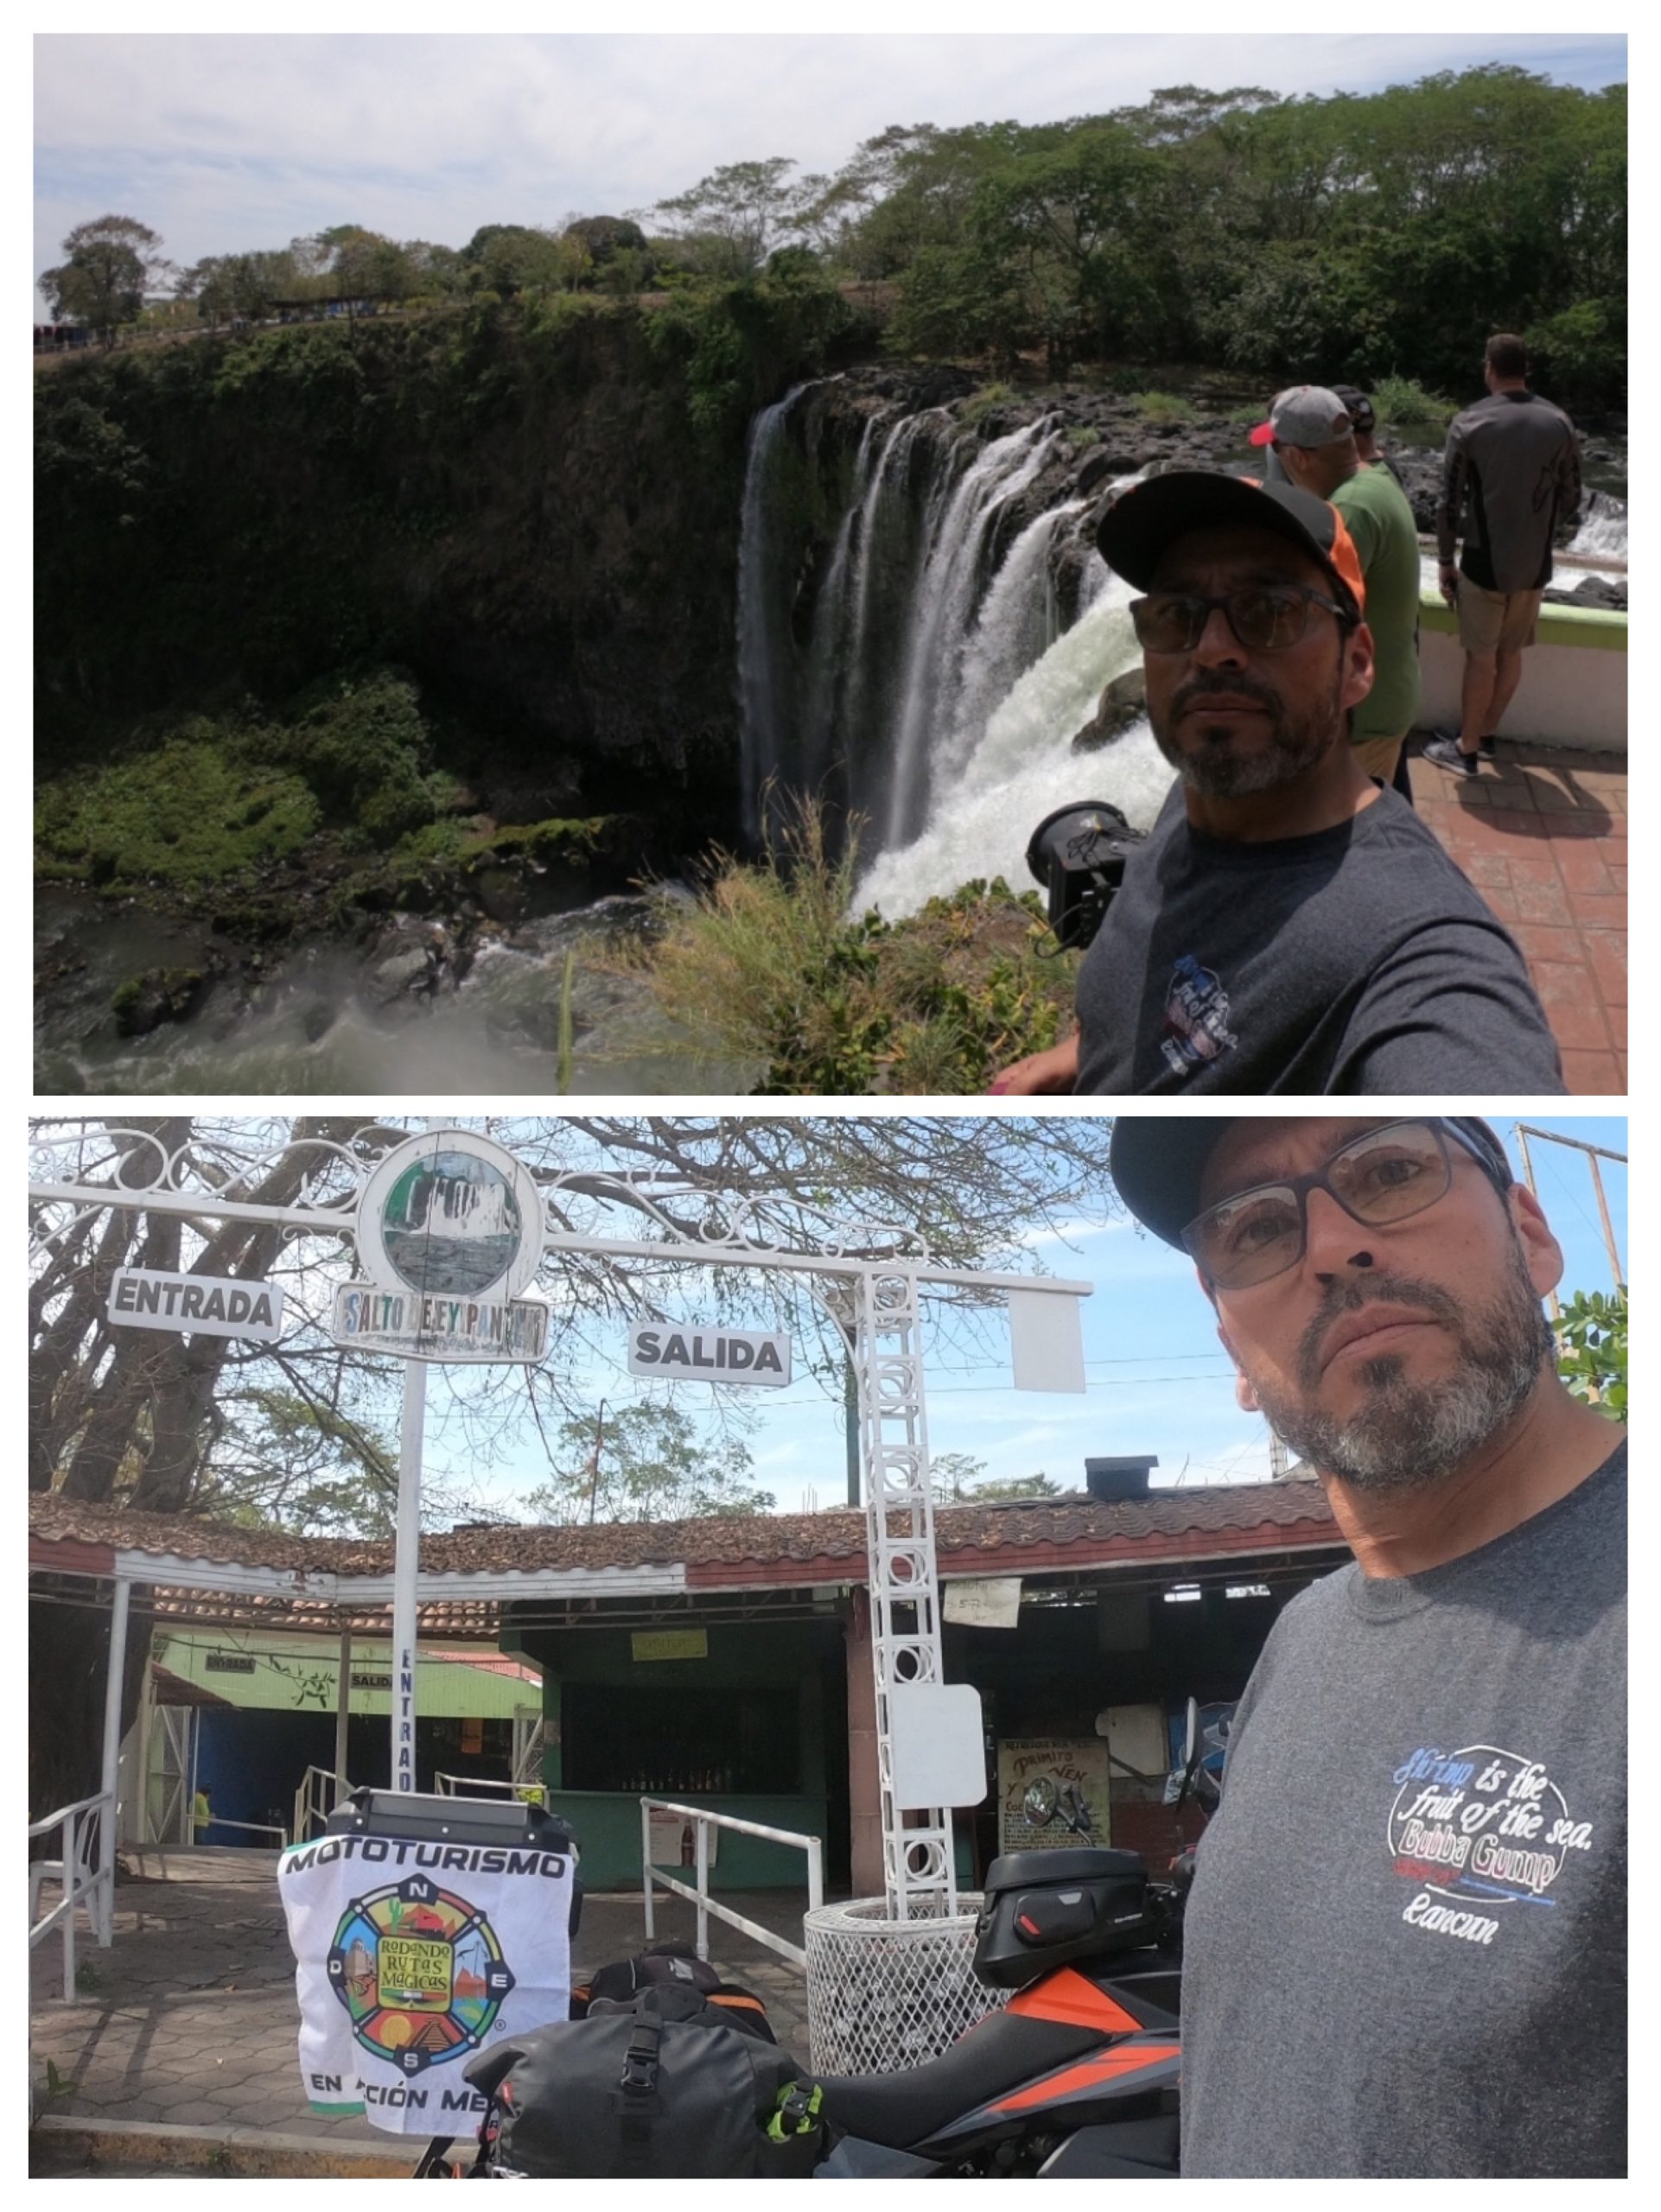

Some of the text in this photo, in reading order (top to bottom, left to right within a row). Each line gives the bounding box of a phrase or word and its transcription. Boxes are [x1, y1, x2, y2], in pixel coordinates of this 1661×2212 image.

[113, 1278, 272, 1326] ENTRADA
[346, 1293, 404, 1333] SALTO
[634, 1331, 782, 1371] SALIDA
[353, 1675, 392, 1688] SALID
[1049, 1764, 1088, 1783] VEN
[1474, 1759, 1506, 1791] is
[1507, 1764, 1549, 1801] the
[1397, 1784, 1593, 1850] fruit of the sea.
[285, 1836, 566, 1879] MOTOTURISMO
[1398, 1818, 1473, 1868] Bubba
[1471, 1834, 1556, 1893] Gump
[409, 1882, 430, 1897] N
[1403, 1892, 1499, 1944] Cancun
[491, 1974, 507, 1987] E
[404, 2053, 419, 2068] S
[311, 2073, 342, 2092] EN
[355, 2077, 429, 2110] CIÓN
